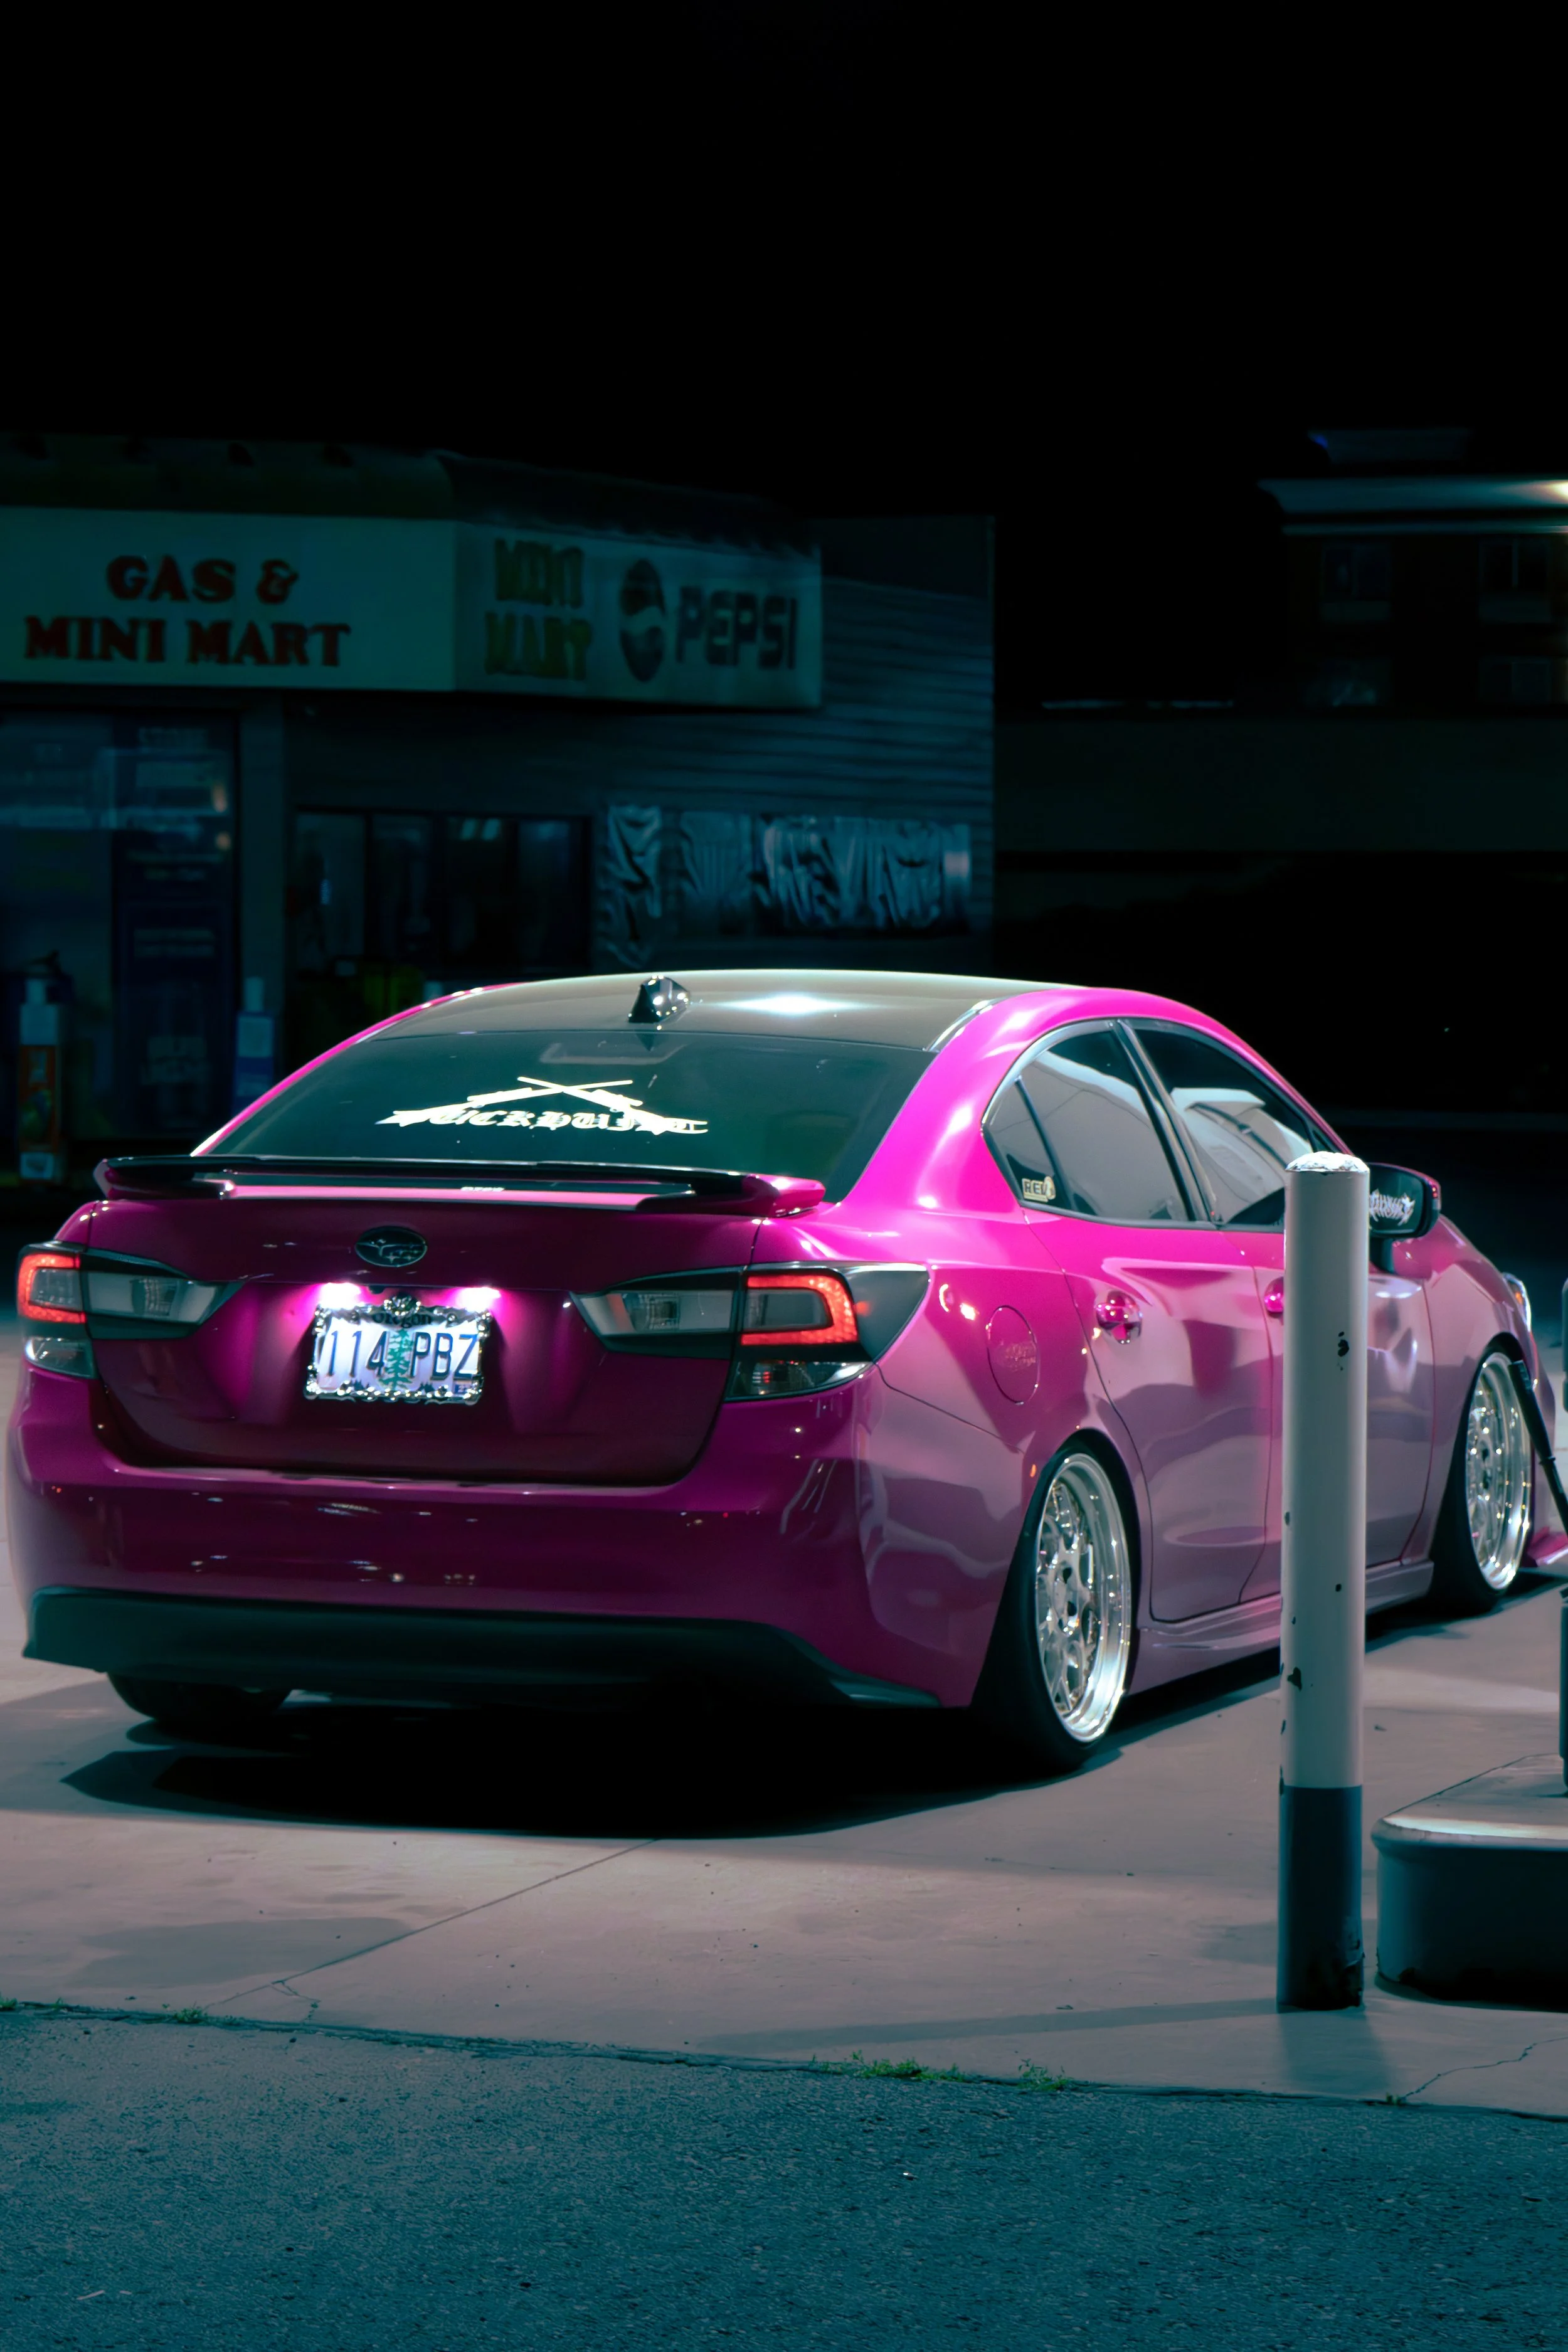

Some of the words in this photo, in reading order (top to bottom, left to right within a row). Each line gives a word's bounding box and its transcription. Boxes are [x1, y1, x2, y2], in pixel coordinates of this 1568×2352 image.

[107, 555, 235, 604] GAS
[256, 559, 299, 605] &
[24, 615, 166, 662] MINI
[186, 620, 352, 666] MART
[675, 585, 798, 669] PEPSI
[327, 1330, 388, 1378] 114
[408, 1331, 479, 1380] PBZ
